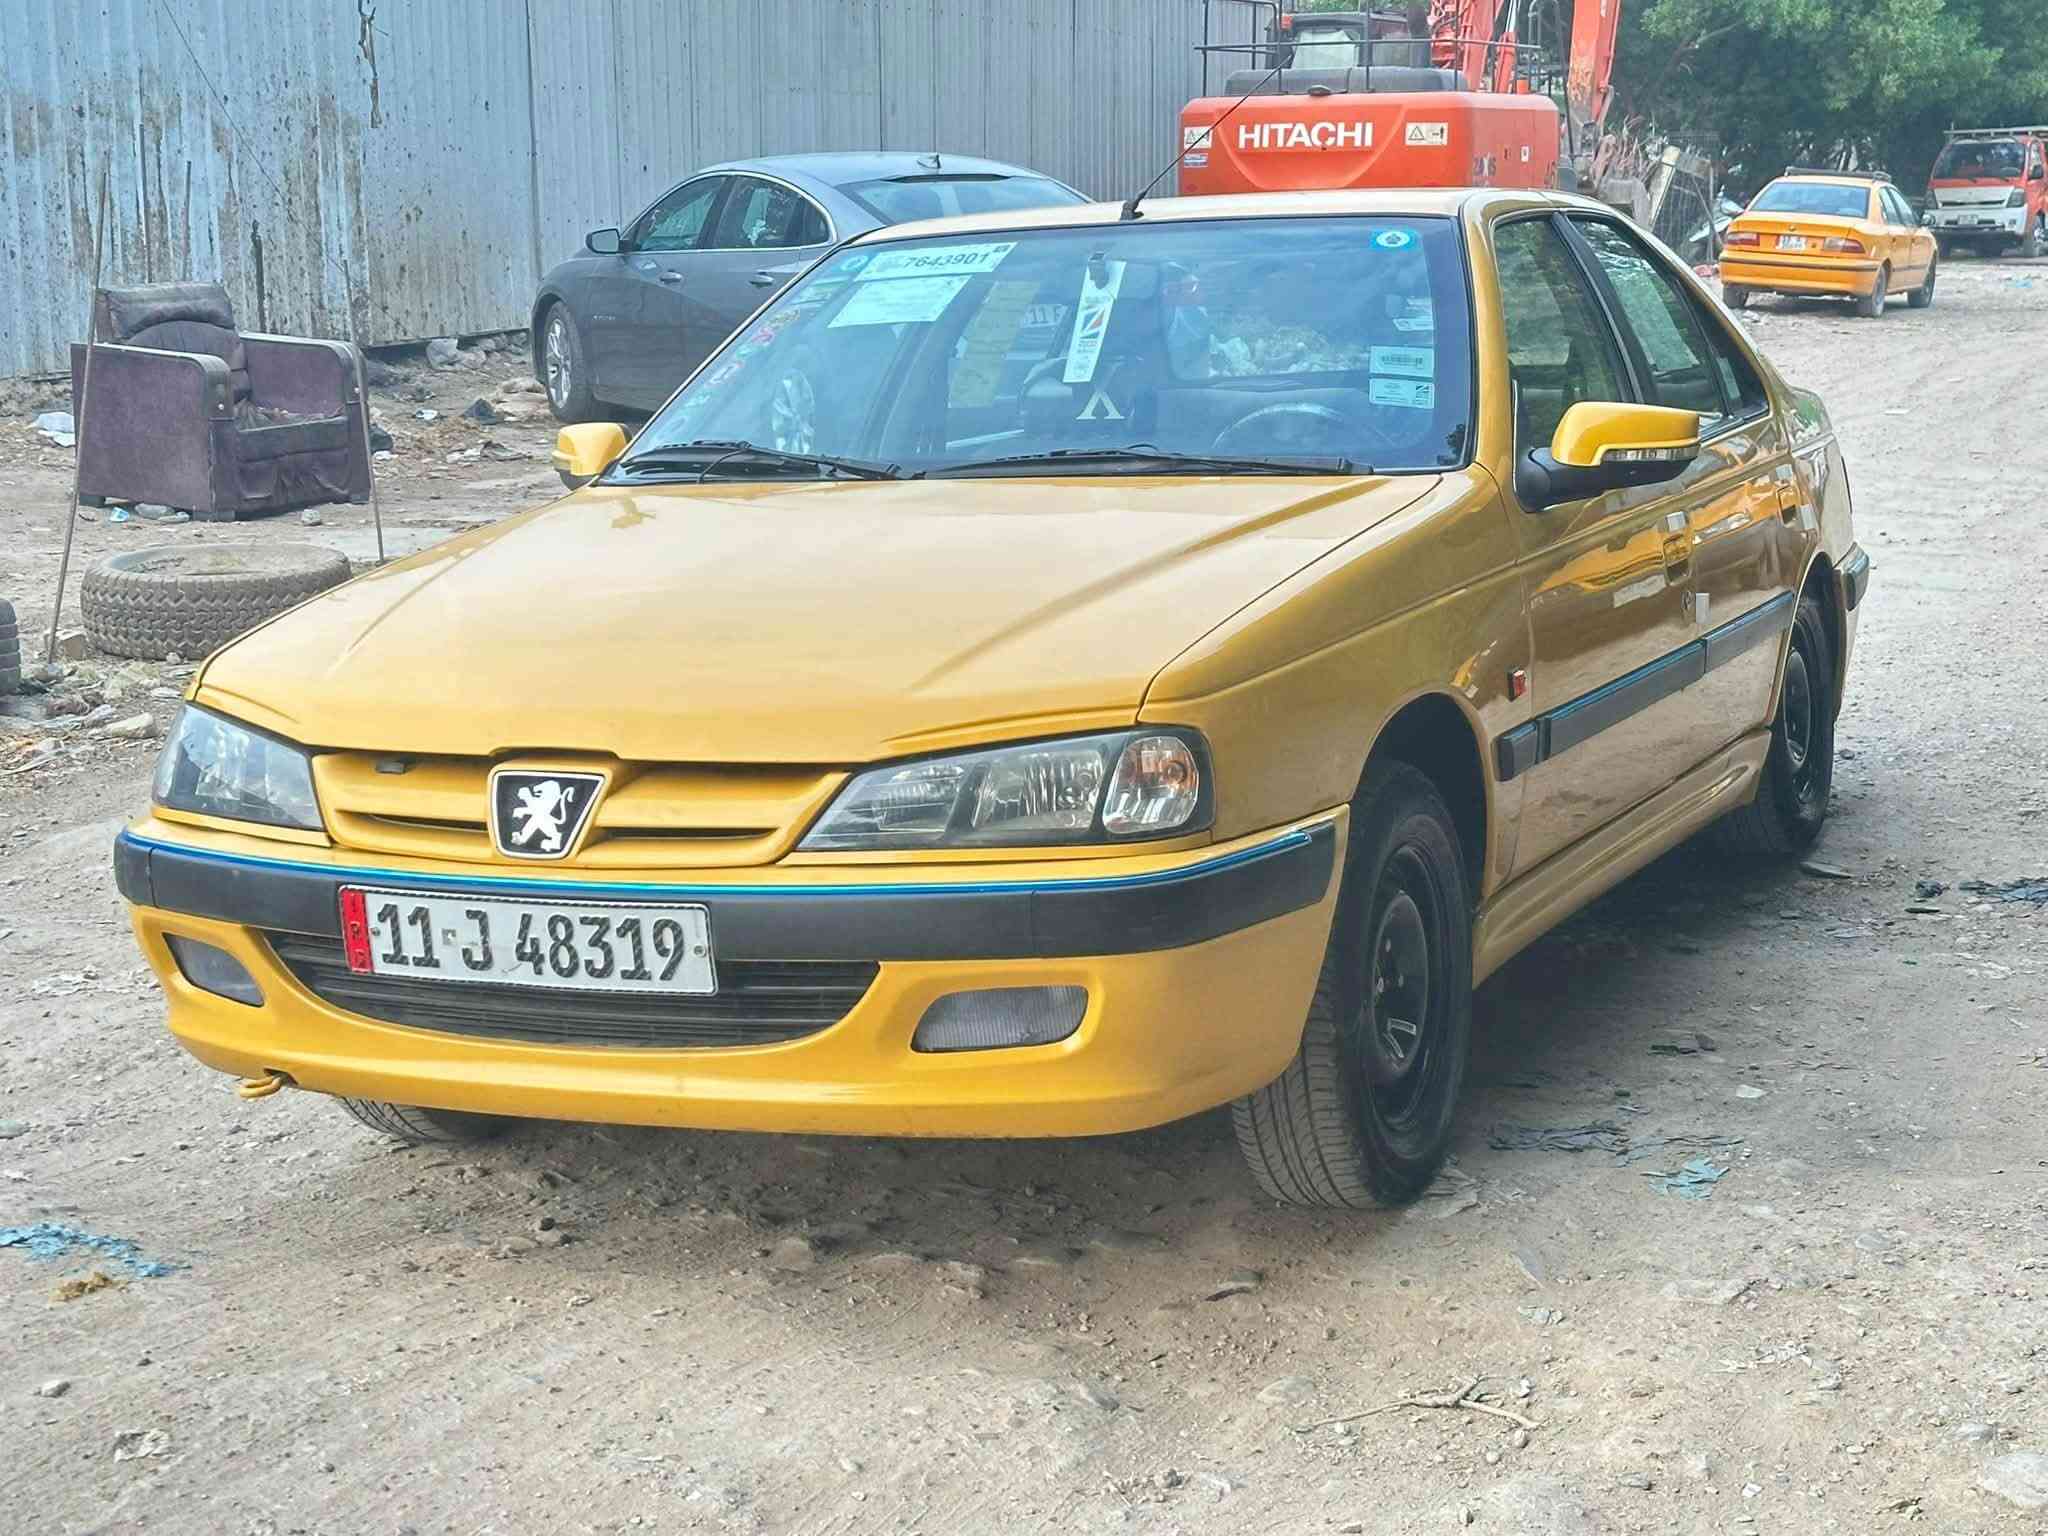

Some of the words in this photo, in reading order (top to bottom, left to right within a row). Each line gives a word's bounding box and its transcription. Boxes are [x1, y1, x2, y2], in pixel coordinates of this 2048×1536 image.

[1238, 121, 1374, 149] HITACHI
[904, 252, 990, 269] 7643901
[377, 903, 441, 969] 11
[461, 908, 494, 972] J
[514, 911, 686, 982] 48319
